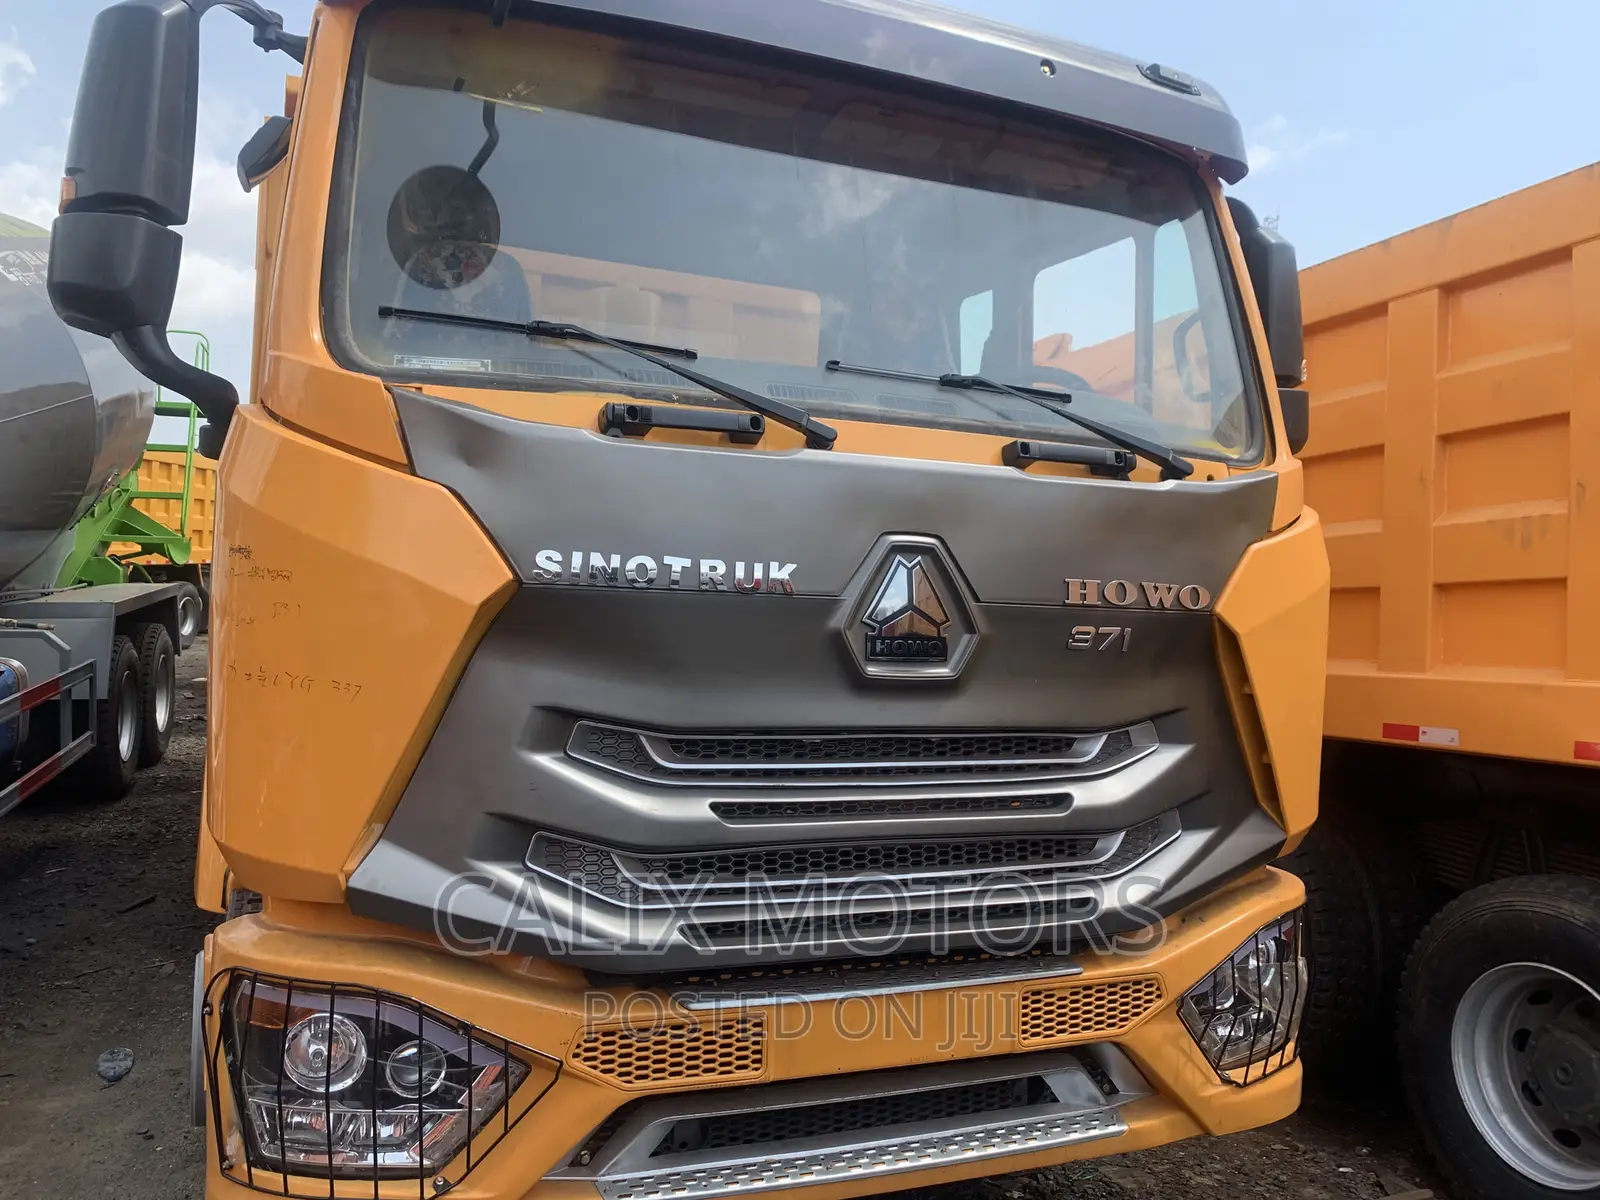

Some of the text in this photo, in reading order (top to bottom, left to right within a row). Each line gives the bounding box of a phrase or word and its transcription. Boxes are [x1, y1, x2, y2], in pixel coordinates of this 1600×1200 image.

[532, 549, 798, 595] SINOTRUK
[1064, 578, 1211, 610] HOWO
[875, 639, 944, 655] HOWO
[1067, 625, 1132, 652] 371
